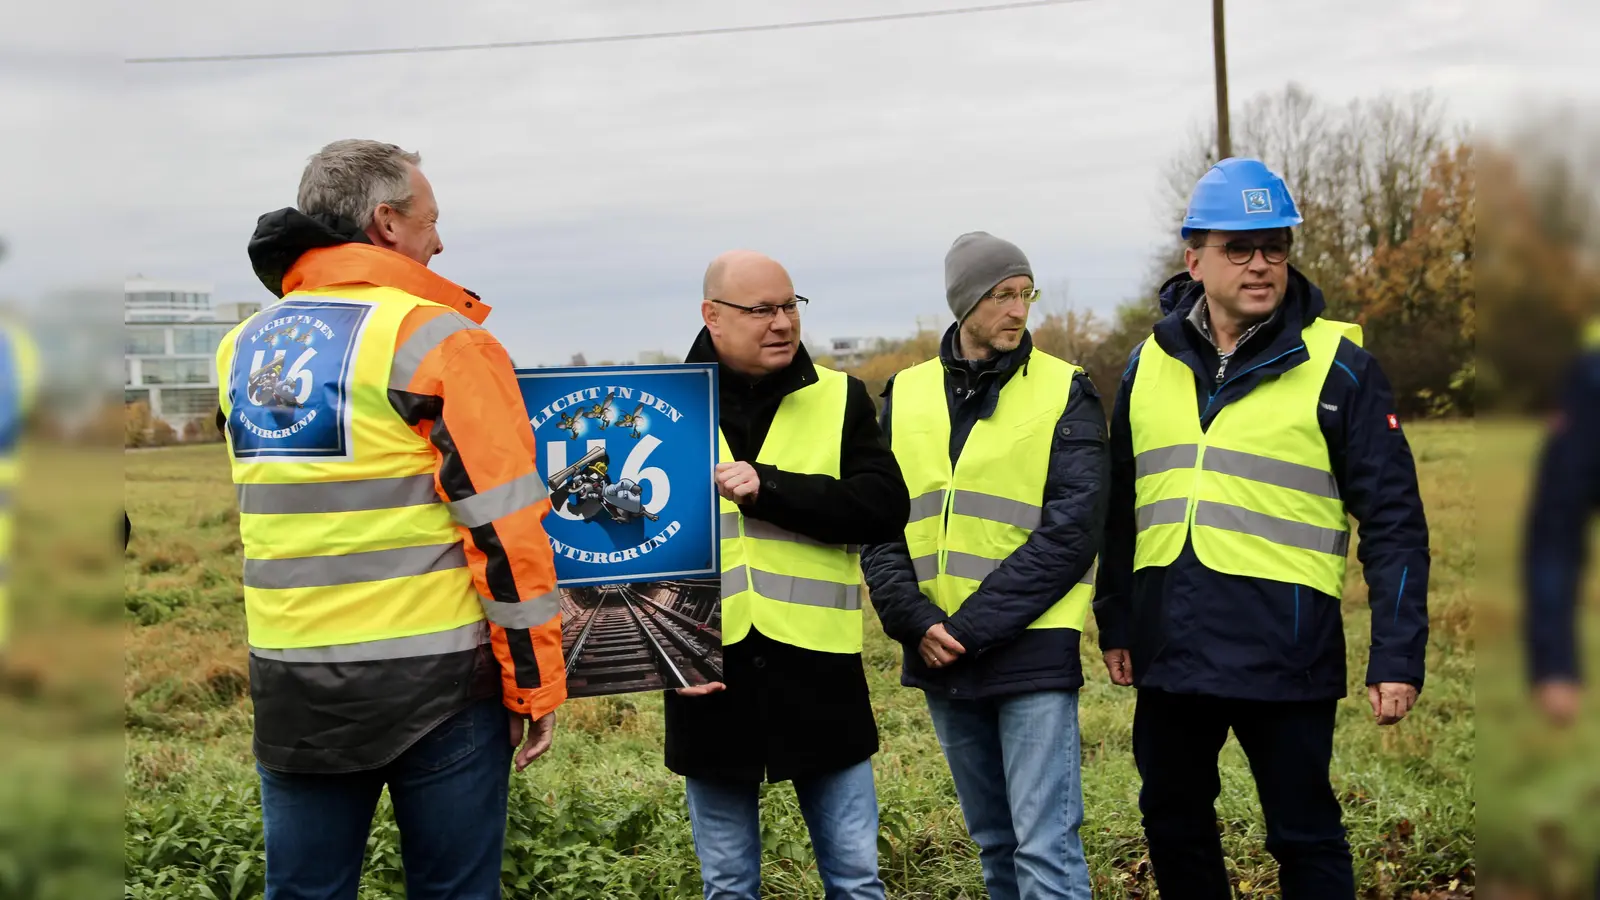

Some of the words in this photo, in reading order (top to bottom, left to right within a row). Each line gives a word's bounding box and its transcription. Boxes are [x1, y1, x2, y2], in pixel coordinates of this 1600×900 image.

[250, 316, 296, 344] LICHT
[298, 315, 311, 325] IN
[313, 319, 336, 341] DEN
[240, 410, 318, 439] UNTERGRUND
[530, 386, 601, 431] LICHT
[605, 386, 635, 399] IN
[638, 390, 684, 423] DEN
[548, 520, 681, 564] NTERGRUND
